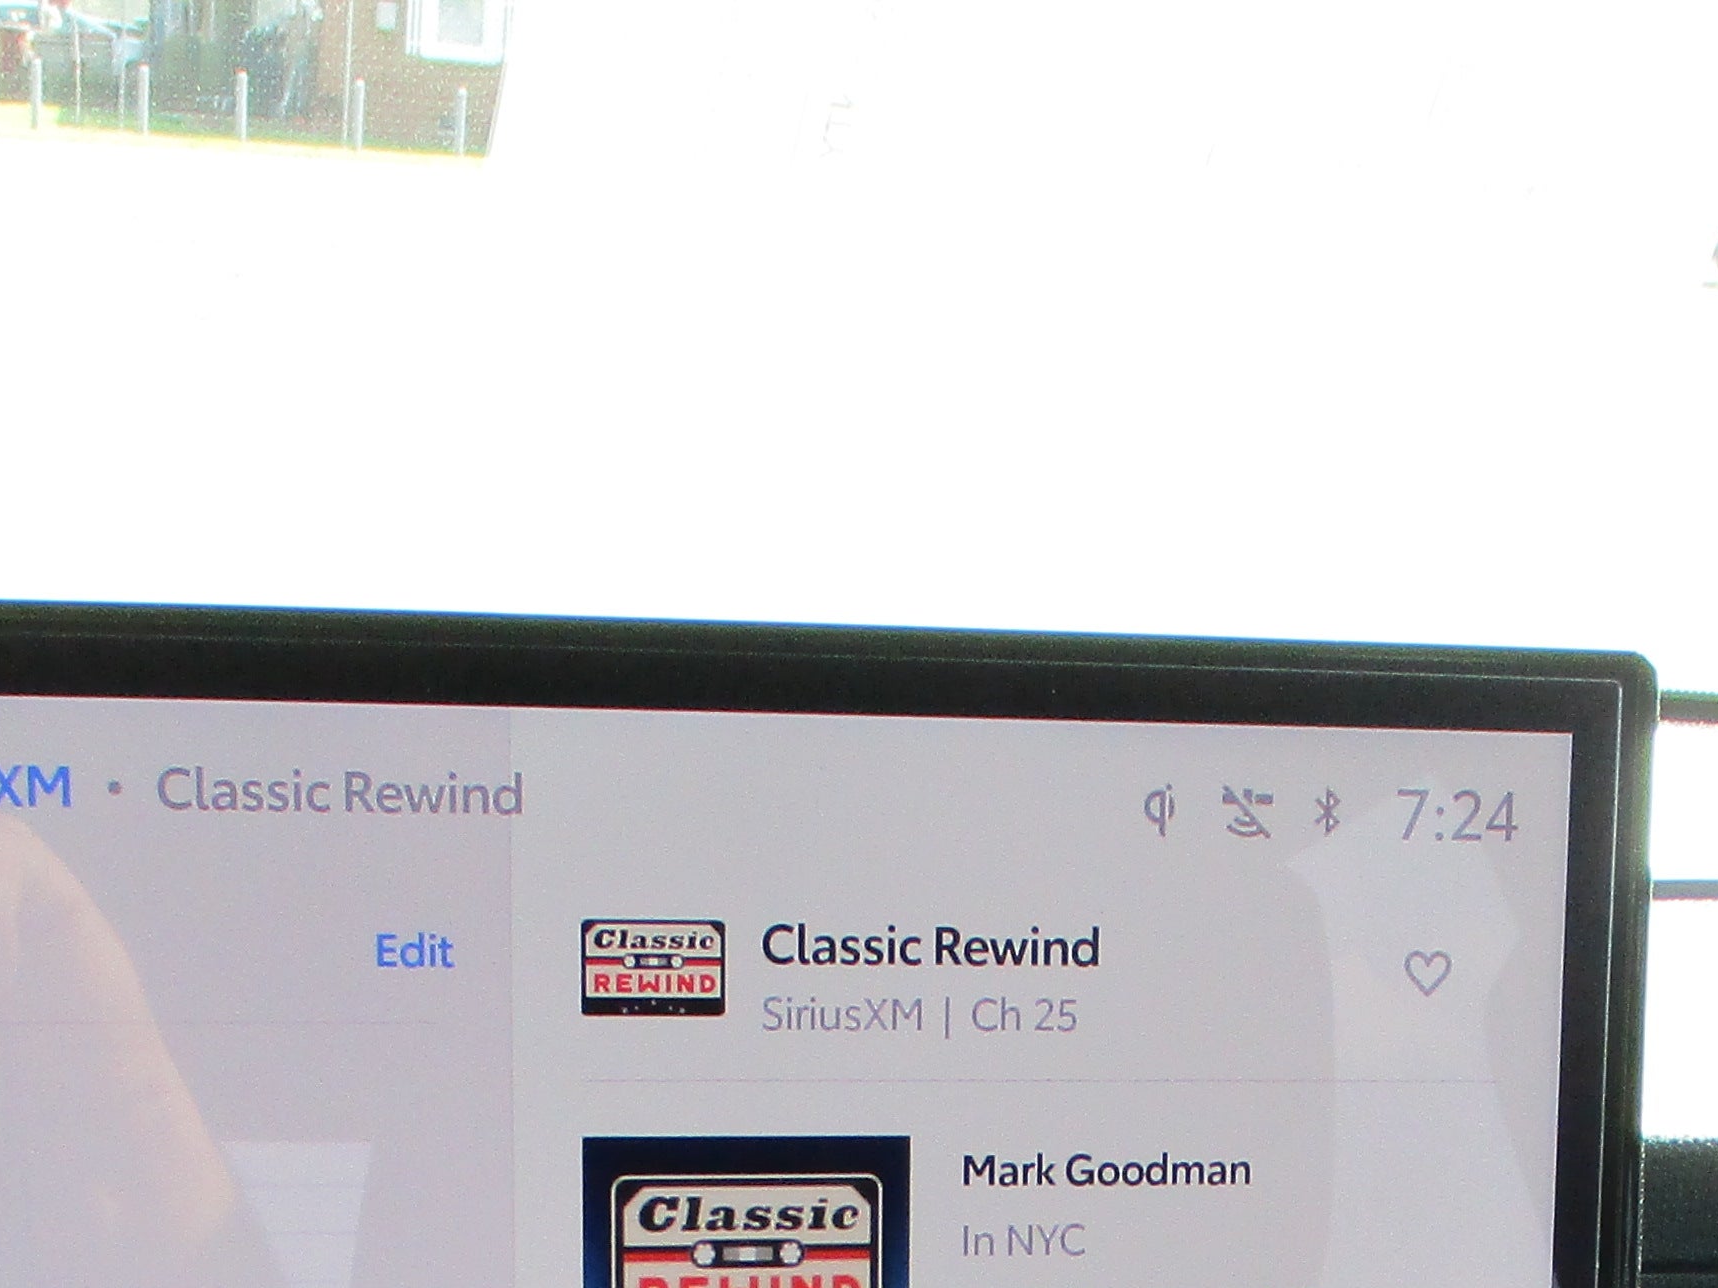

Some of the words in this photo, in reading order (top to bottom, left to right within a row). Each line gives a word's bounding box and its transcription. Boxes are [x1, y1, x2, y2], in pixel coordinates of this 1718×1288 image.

[156, 767, 331, 815] Classic
[345, 770, 525, 818] Rewind
[1397, 788, 1519, 842] 7:24
[376, 932, 455, 970] Edit
[589, 928, 715, 955] Classic
[761, 924, 922, 969] Classic
[935, 925, 1101, 970] Rewind
[592, 971, 716, 997] REWIND
[761, 996, 923, 1034] SiriusXM
[971, 996, 1023, 1032] Ch
[1033, 996, 1078, 1033] 25
[961, 1152, 1055, 1187] Mark
[1065, 1152, 1252, 1189] Goodman
[635, 1197, 861, 1236] Classic
[961, 1224, 997, 1258] In
[1007, 1223, 1086, 1258] NYC
